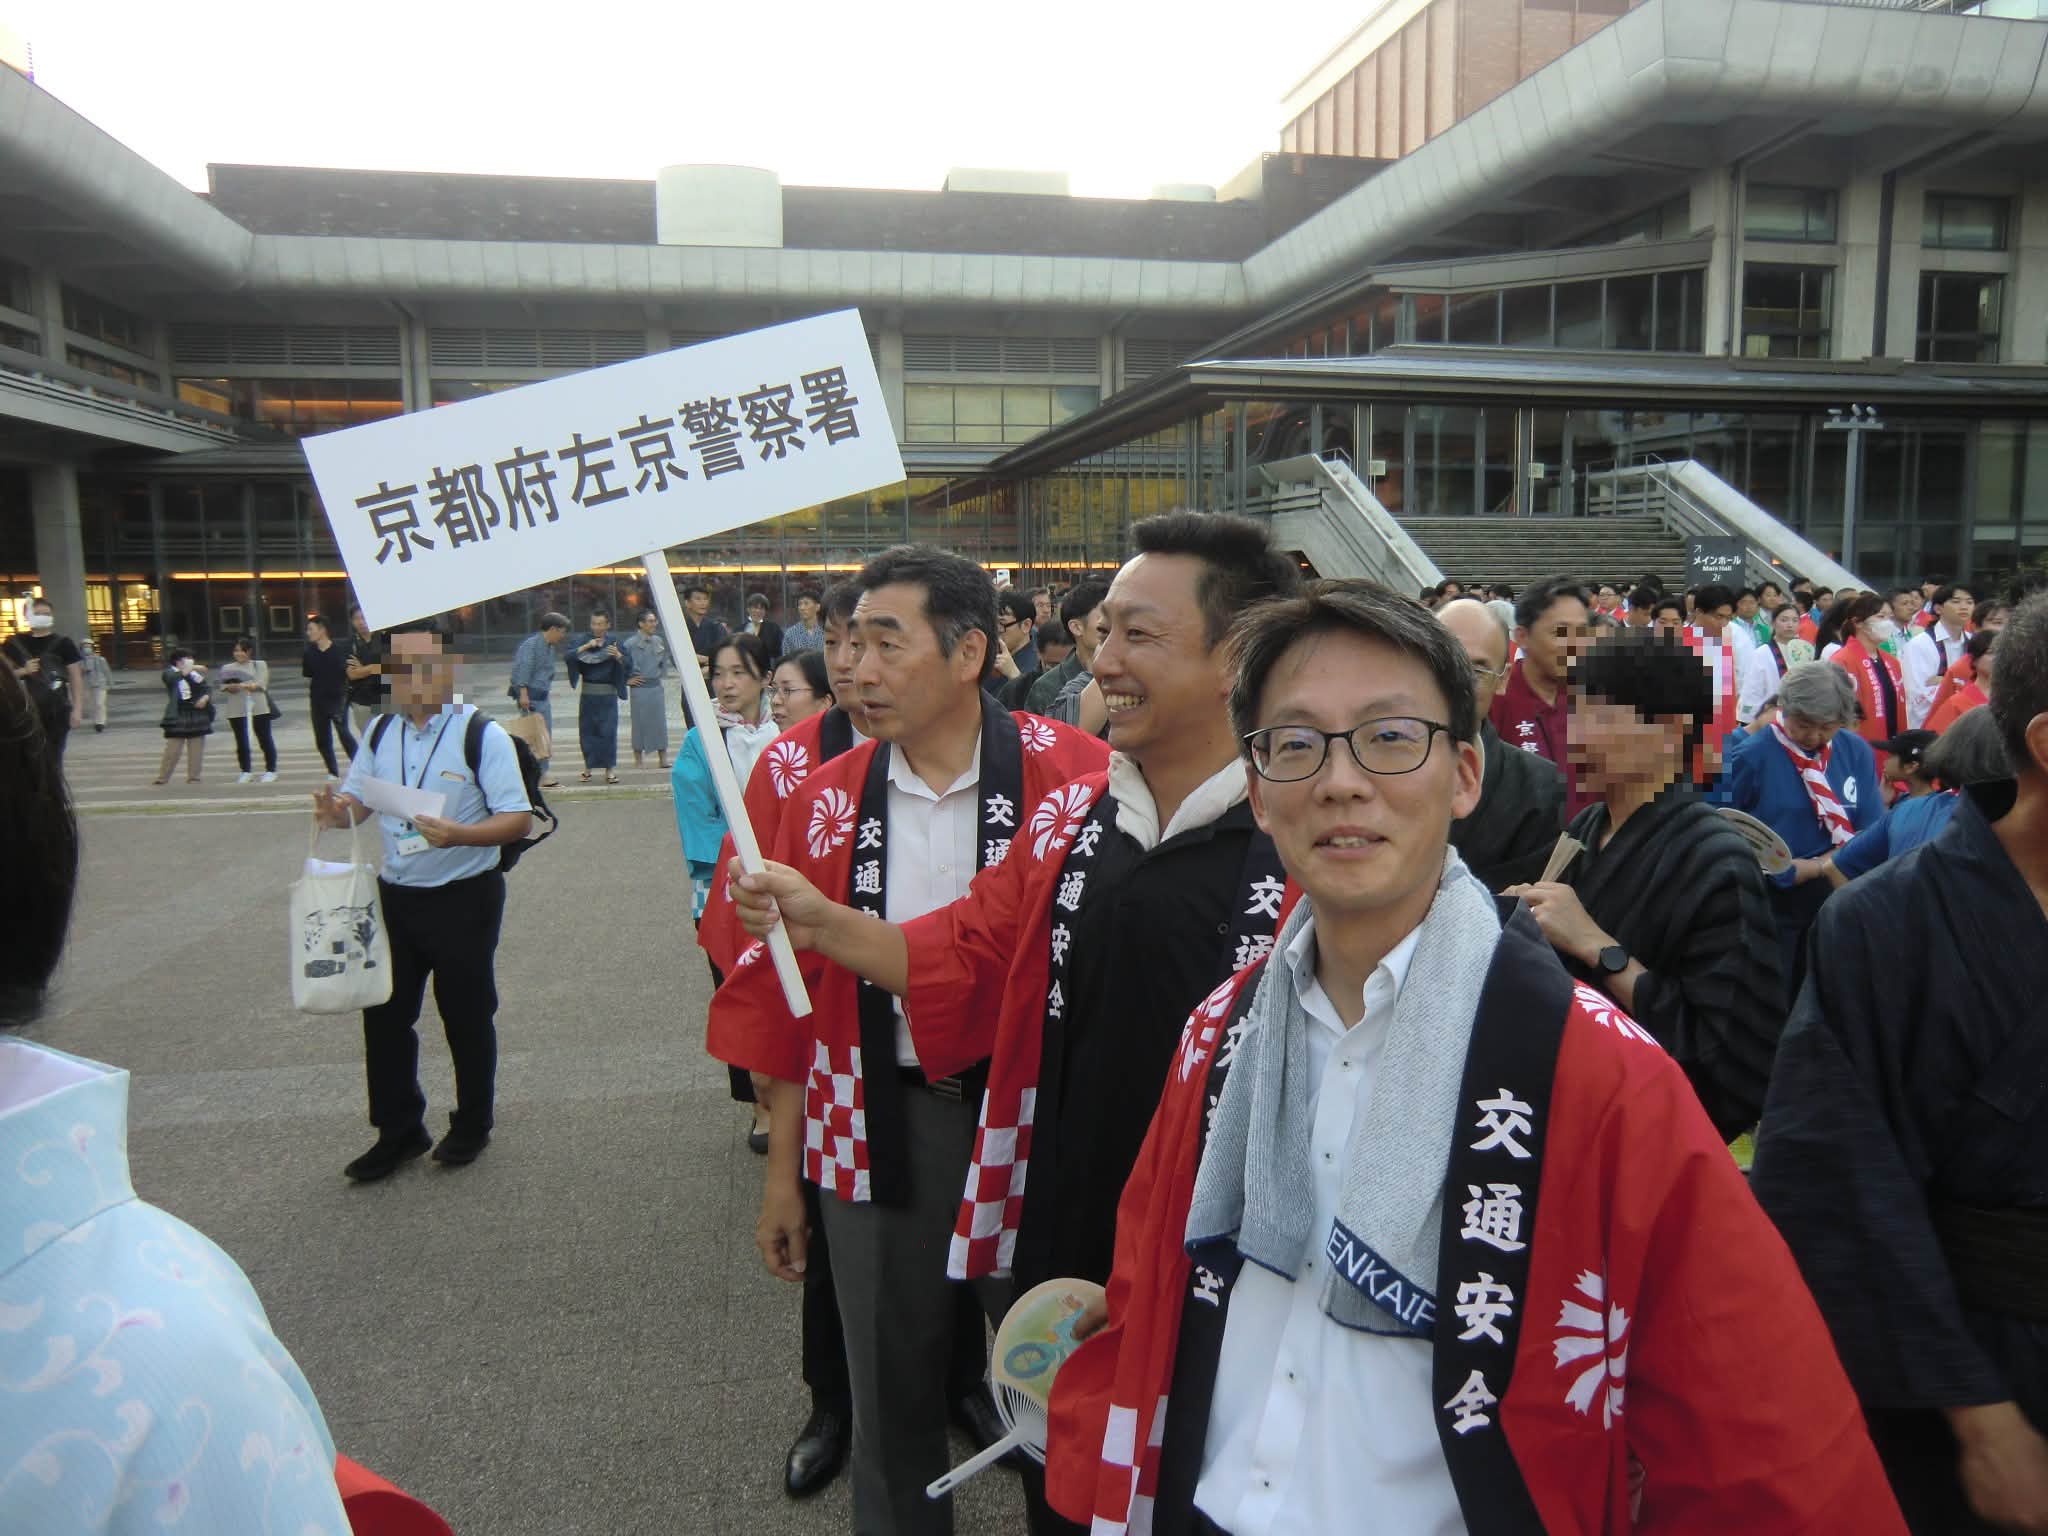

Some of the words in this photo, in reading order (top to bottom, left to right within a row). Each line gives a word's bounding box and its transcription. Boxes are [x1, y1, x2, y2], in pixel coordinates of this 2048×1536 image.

[355, 366, 860, 563] 京都府左京警察署
[1693, 556, 1741, 565] メインホール
[1048, 819, 1102, 1019] 交通安全
[1443, 1088, 1533, 1434] 交通安全
